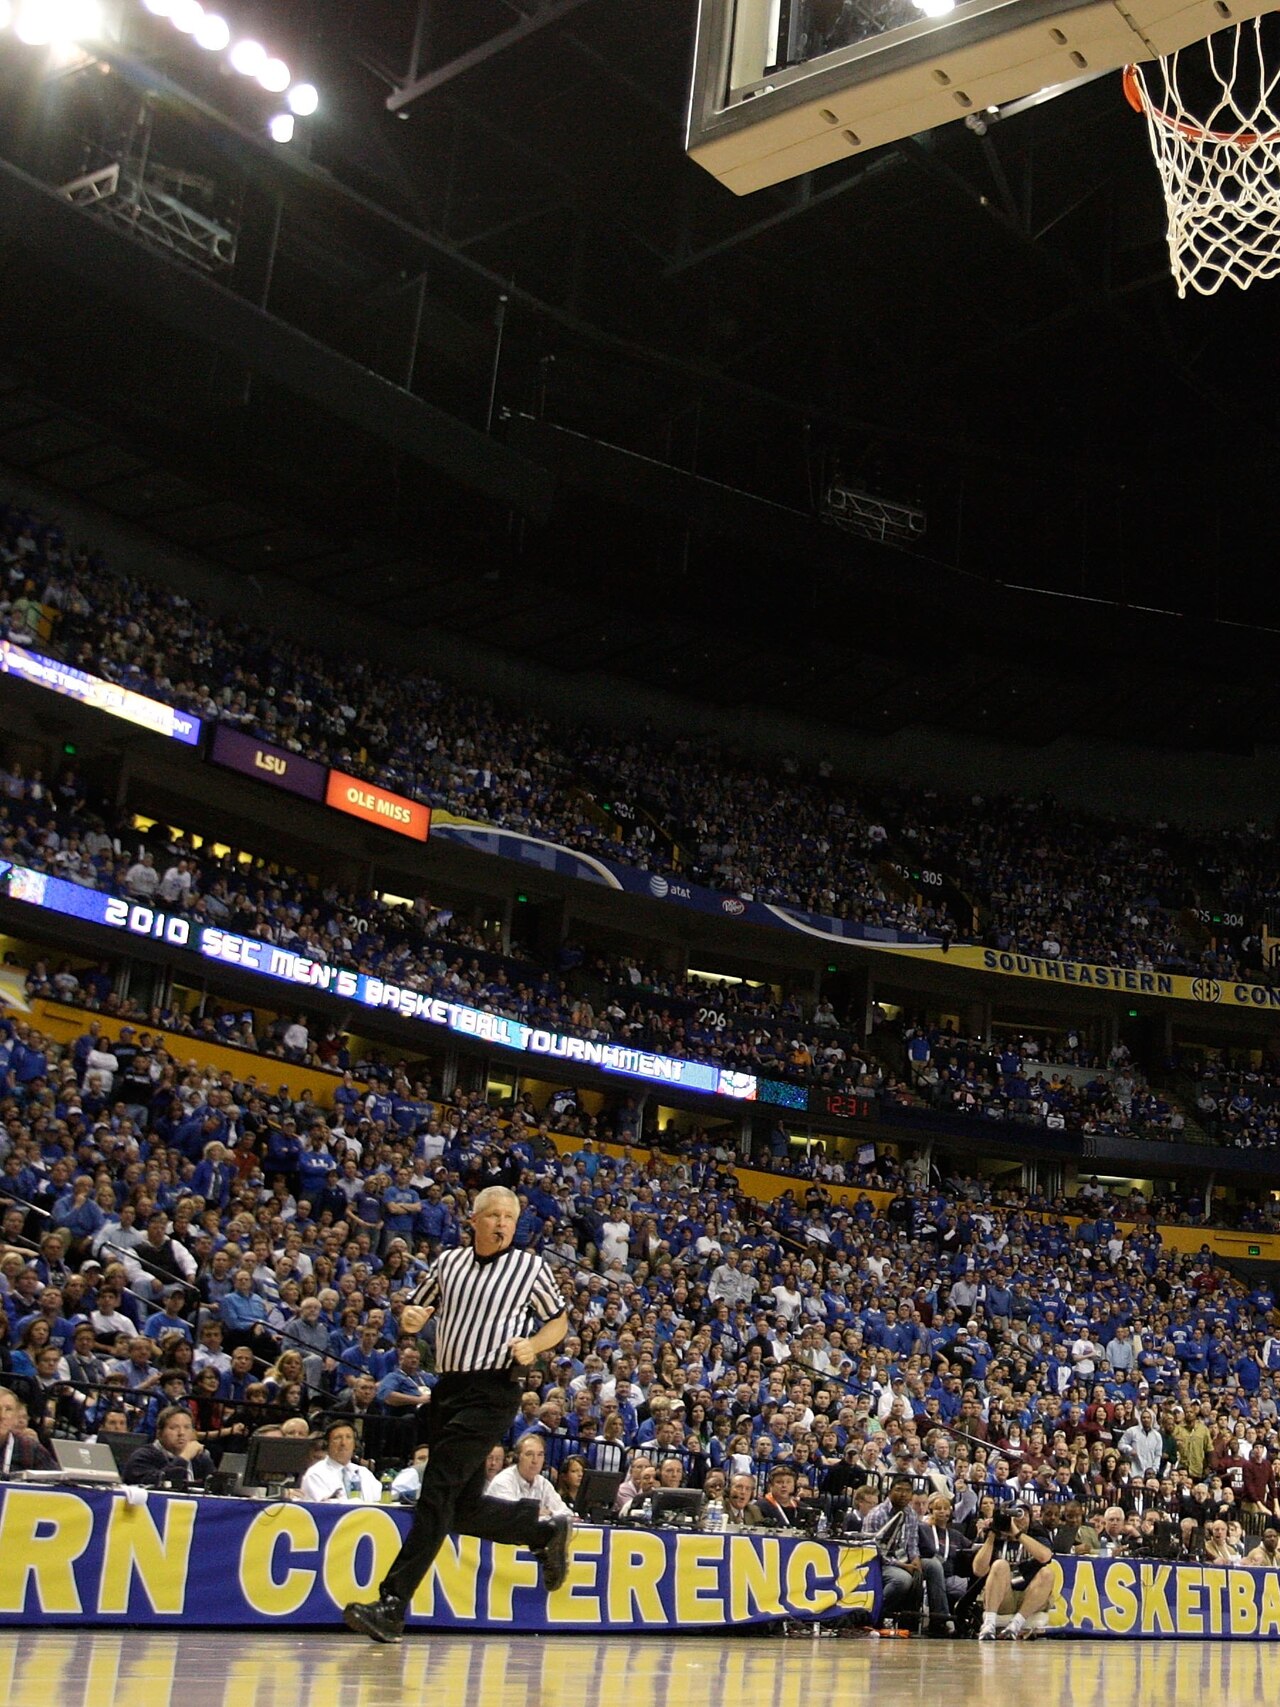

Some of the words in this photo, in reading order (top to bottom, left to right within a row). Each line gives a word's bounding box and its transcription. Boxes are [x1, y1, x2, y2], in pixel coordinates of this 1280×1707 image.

[255, 750, 287, 775] LSU
[347, 787, 376, 810] OLE
[376, 798, 411, 823] MISS
[922, 869, 943, 886] 305
[670, 885, 692, 899] at&t
[1223, 912, 1244, 927] 304
[983, 949, 1173, 994] SOUTHEASTERN
[1193, 979, 1219, 1001] SEC
[104, 896, 190, 945] 2010
[201, 926, 262, 967] SEC
[269, 947, 358, 997] MEN'S
[364, 978, 511, 1043] BASKETBALL
[517, 1024, 685, 1081] TOURNAMENT
[699, 1007, 727, 1027] 206
[827, 1096, 869, 1117] 12:31
[238, 1505, 875, 1623] CONFERENCE
